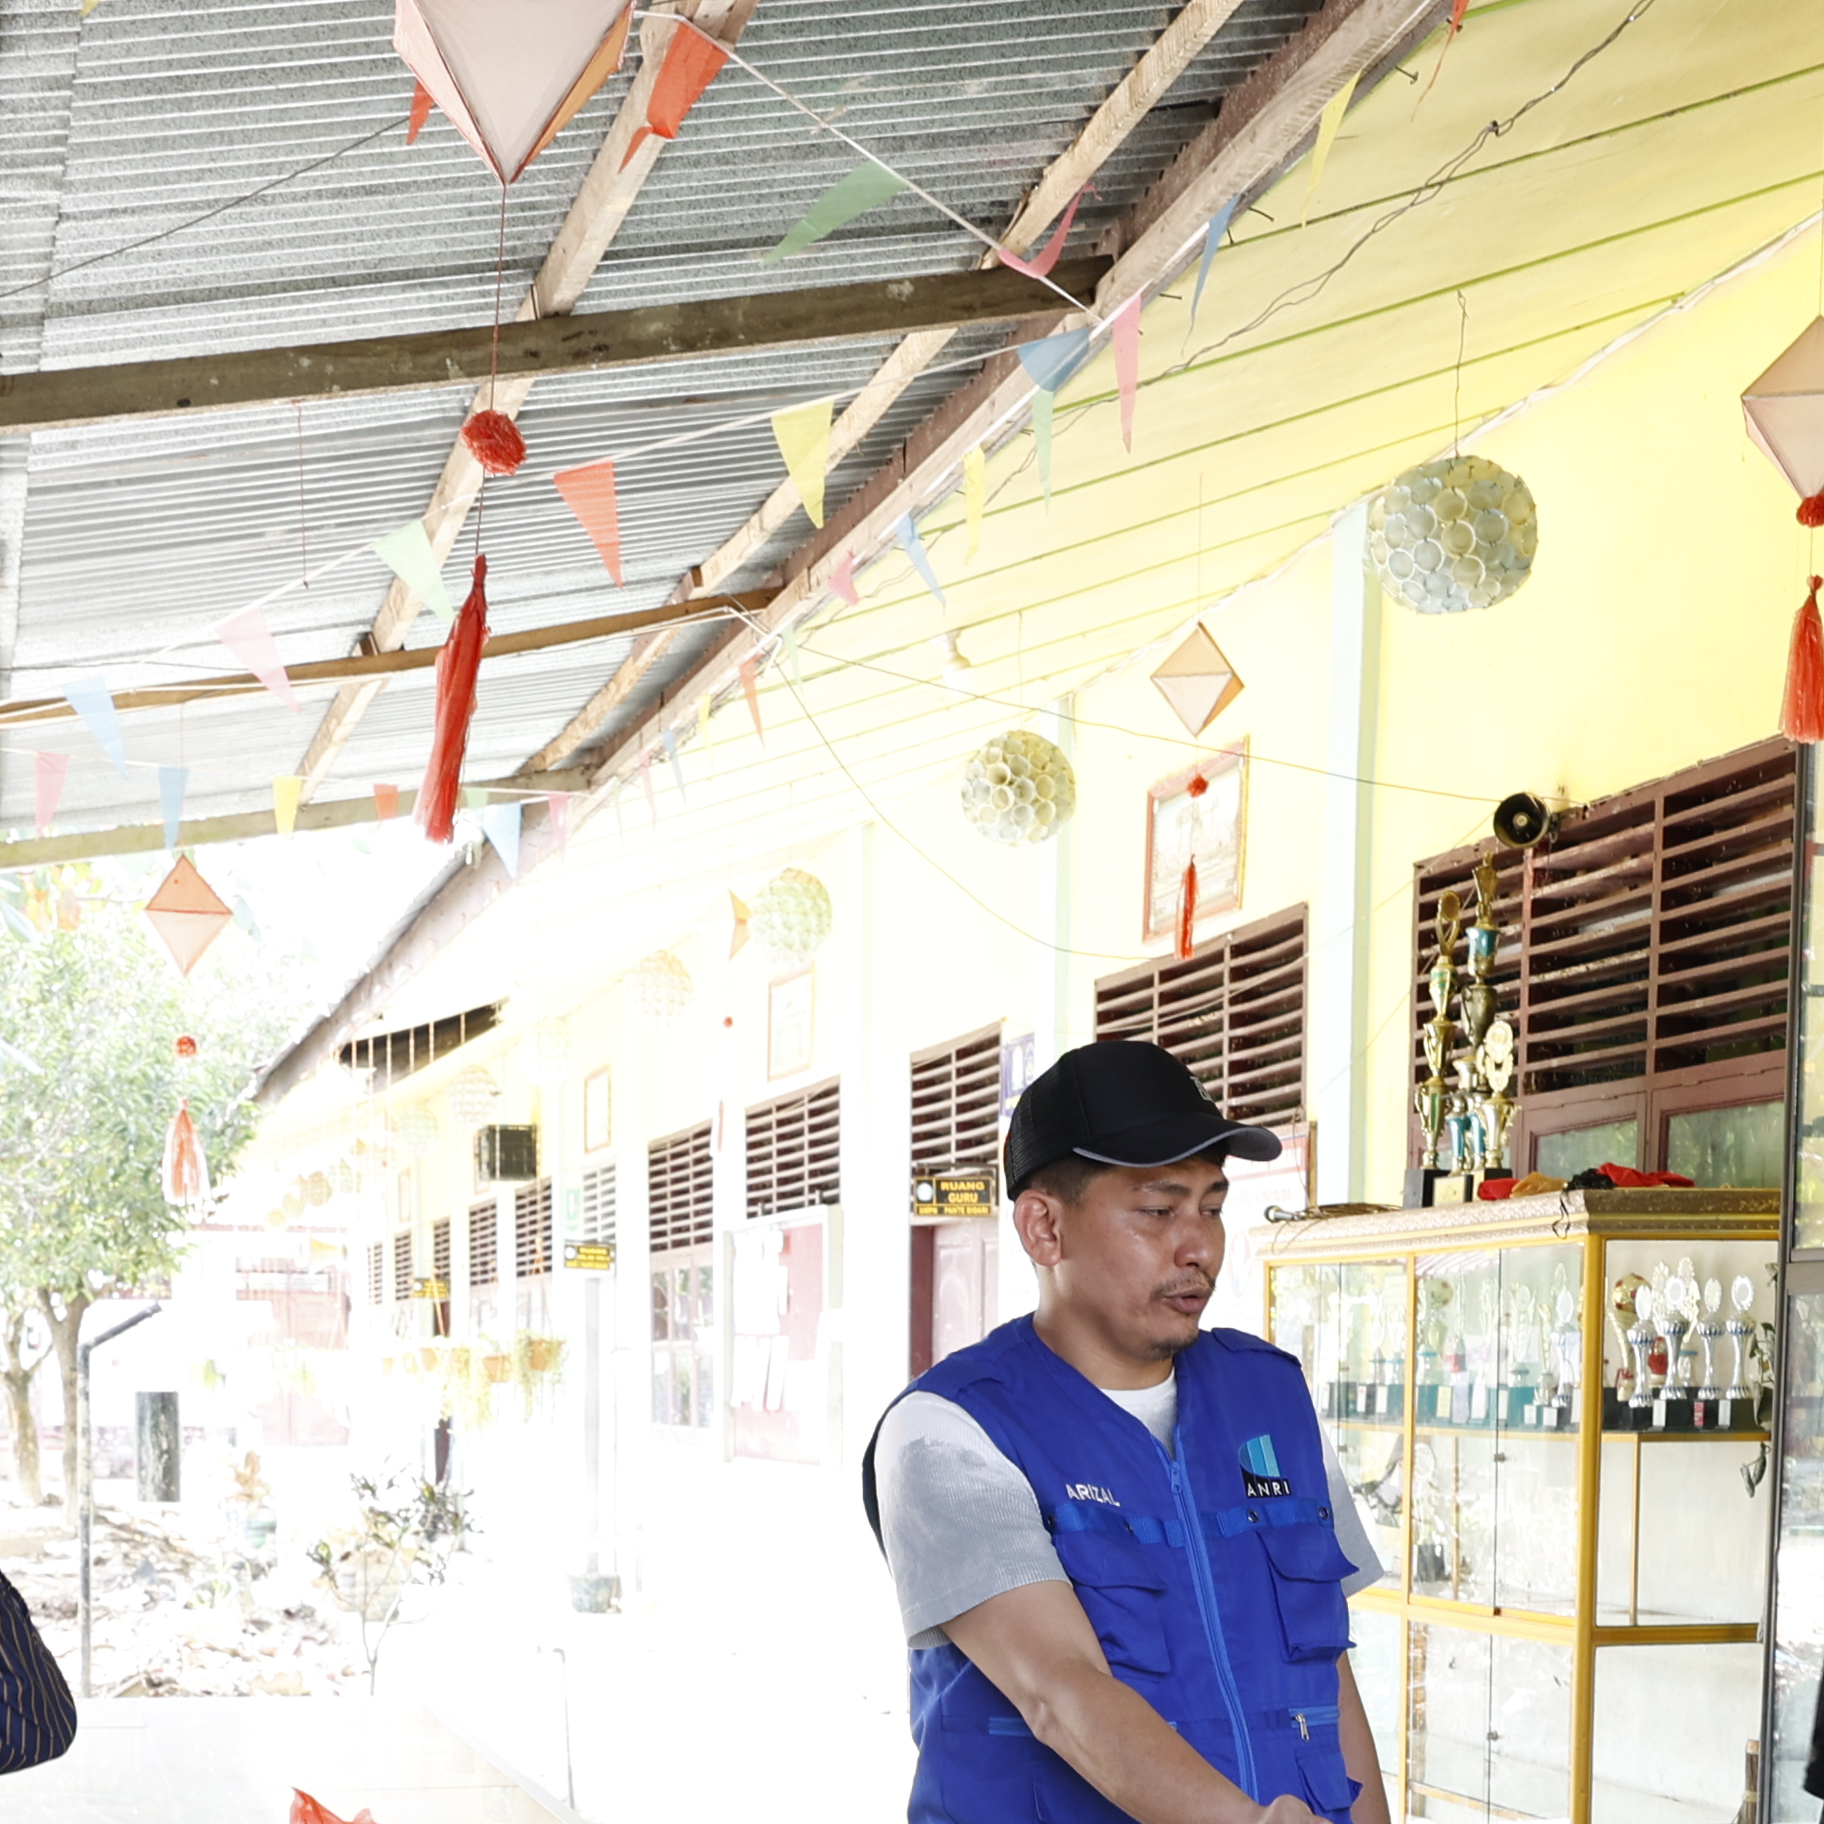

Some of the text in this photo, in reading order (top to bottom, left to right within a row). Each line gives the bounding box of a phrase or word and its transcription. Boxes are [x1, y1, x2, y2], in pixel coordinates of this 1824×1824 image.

[940, 1181, 985, 1191] RUANG
[948, 1192, 979, 1203] GURU
[1064, 1483, 1121, 1508] ARIZAL
[1246, 1479, 1291, 1499] ANRI
